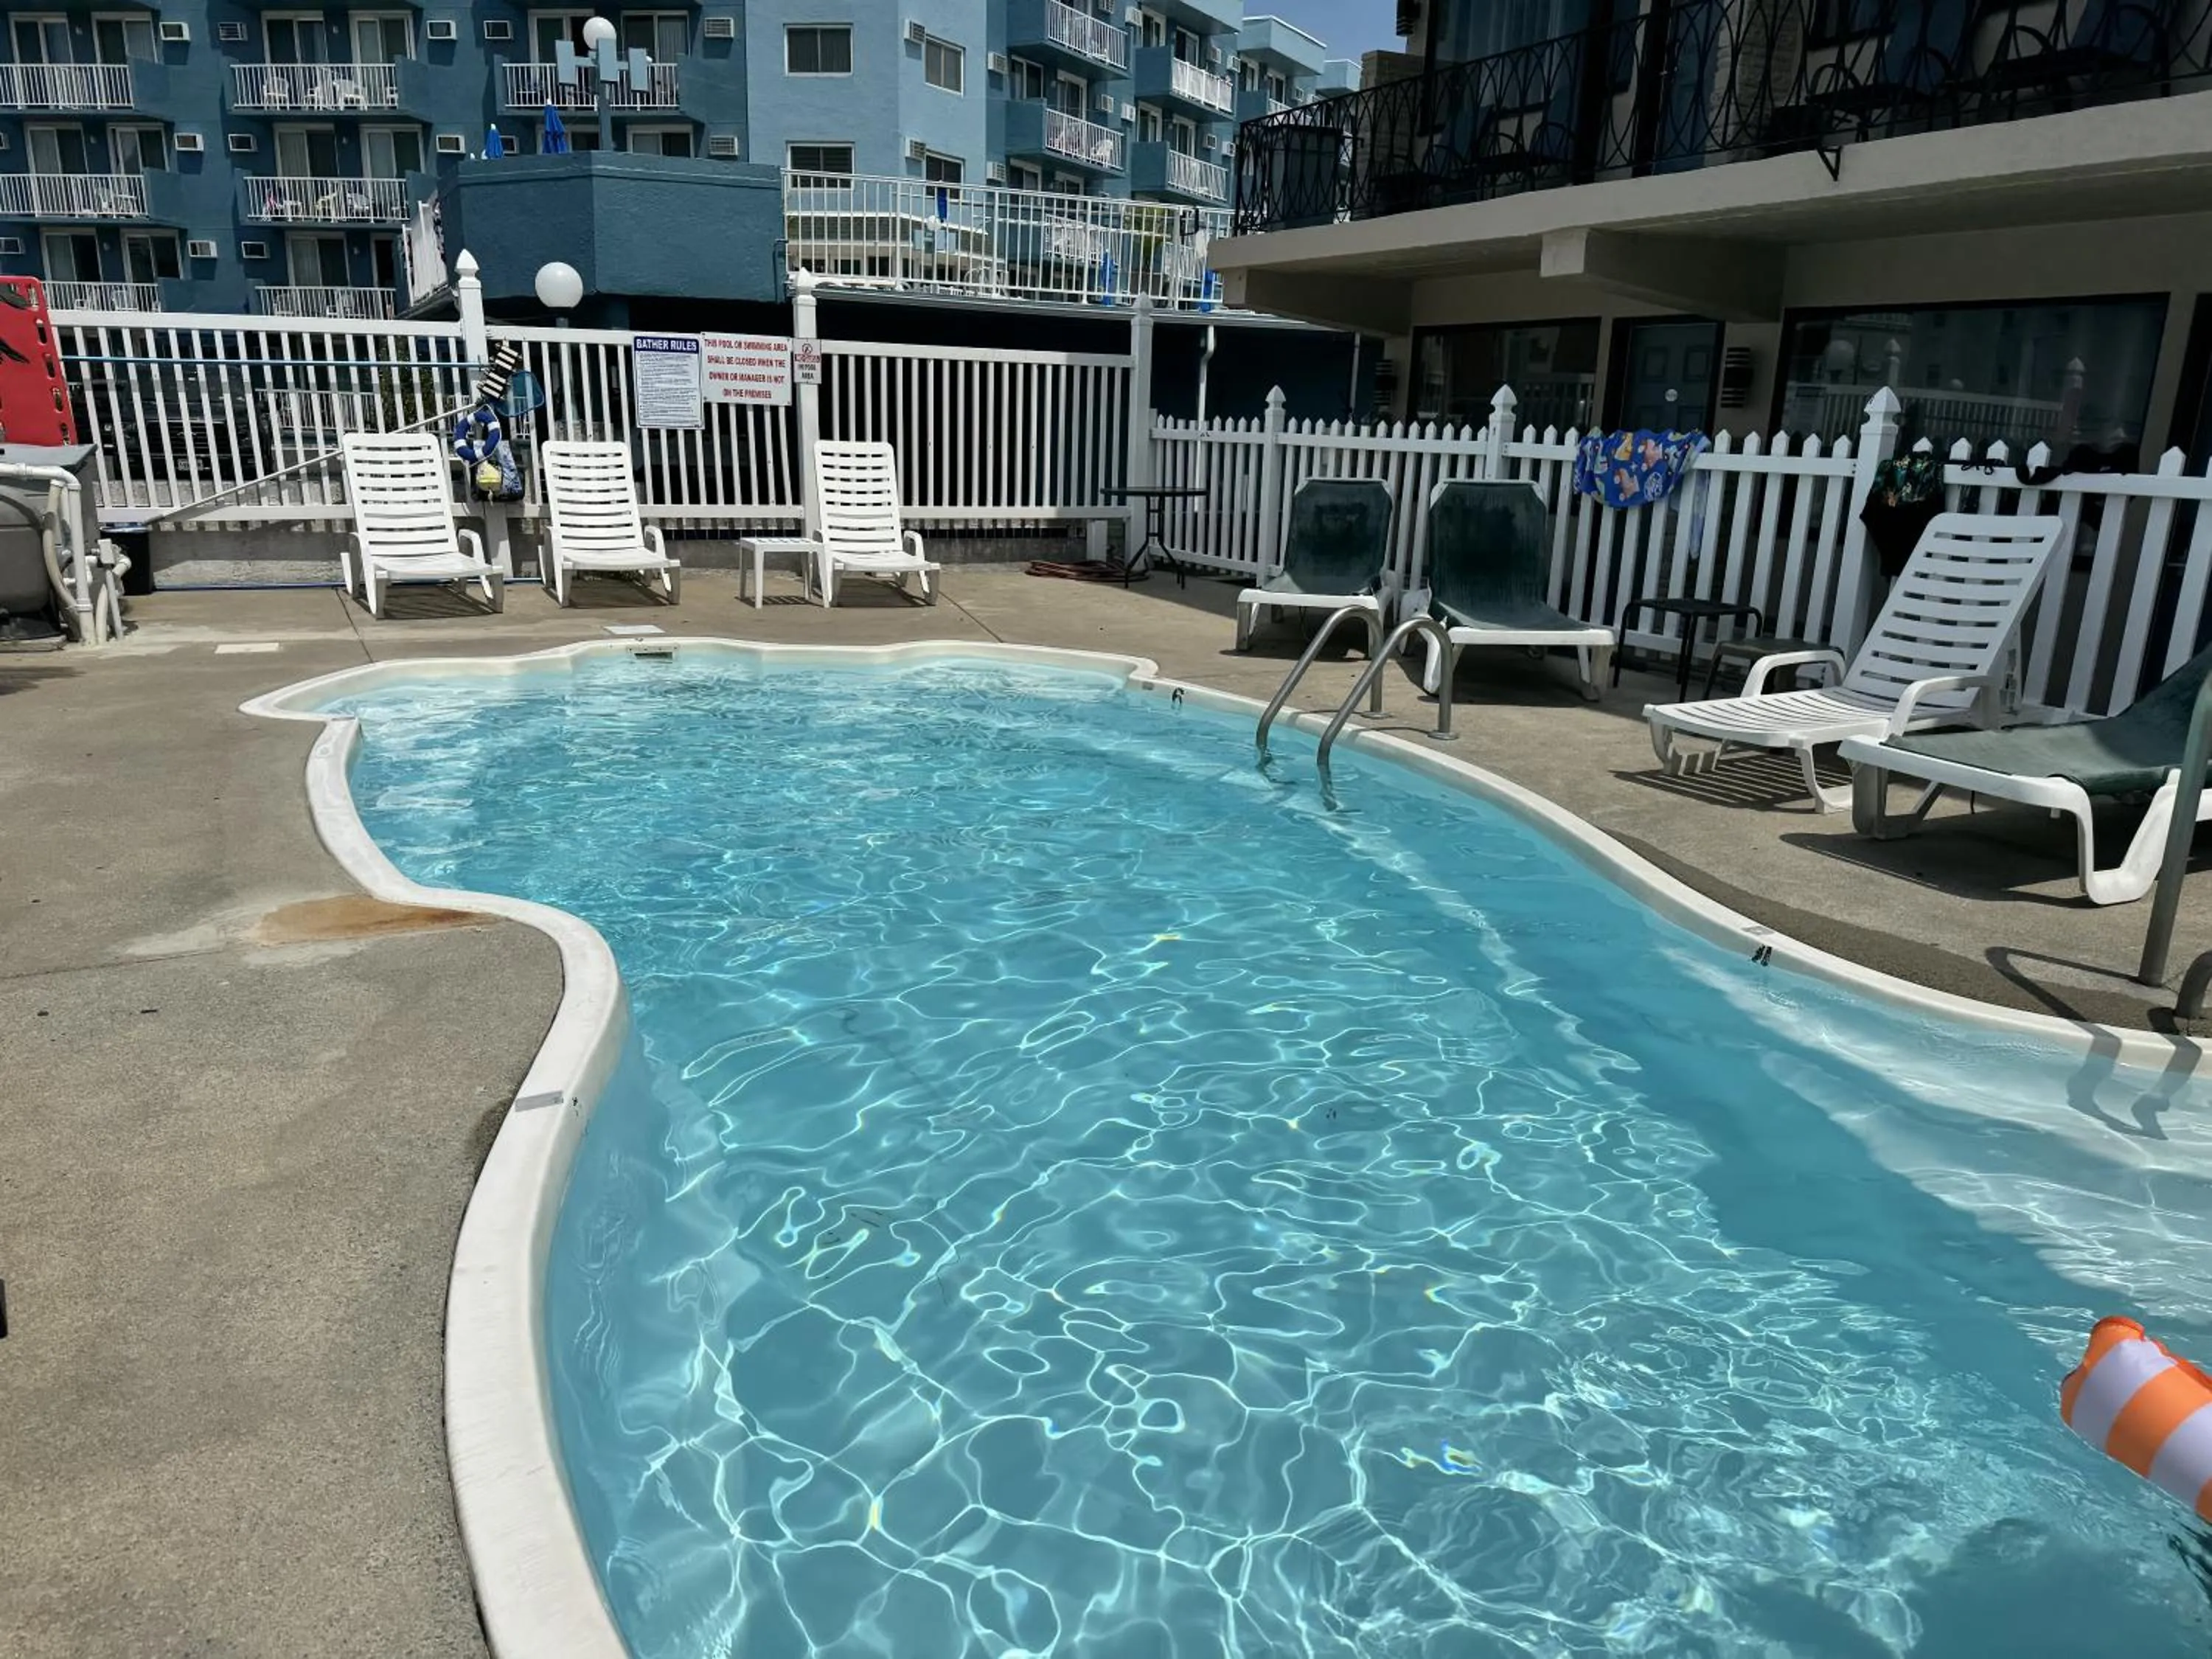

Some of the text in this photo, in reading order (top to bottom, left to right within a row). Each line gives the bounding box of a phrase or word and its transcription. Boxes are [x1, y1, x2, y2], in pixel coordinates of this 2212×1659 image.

[636, 338, 697, 351] BATHER RULES
[719, 340, 733, 348] POOL
[773, 343, 787, 351] AREA
[708, 355, 725, 364] SHALL
[726, 356, 734, 365] BE
[735, 357, 757, 366] CLOSED
[758, 358, 773, 366] WHEN
[709, 372, 785, 384] OWNER OR MANAGER IS NOT
[723, 388, 771, 398] ON THE PREMISES
